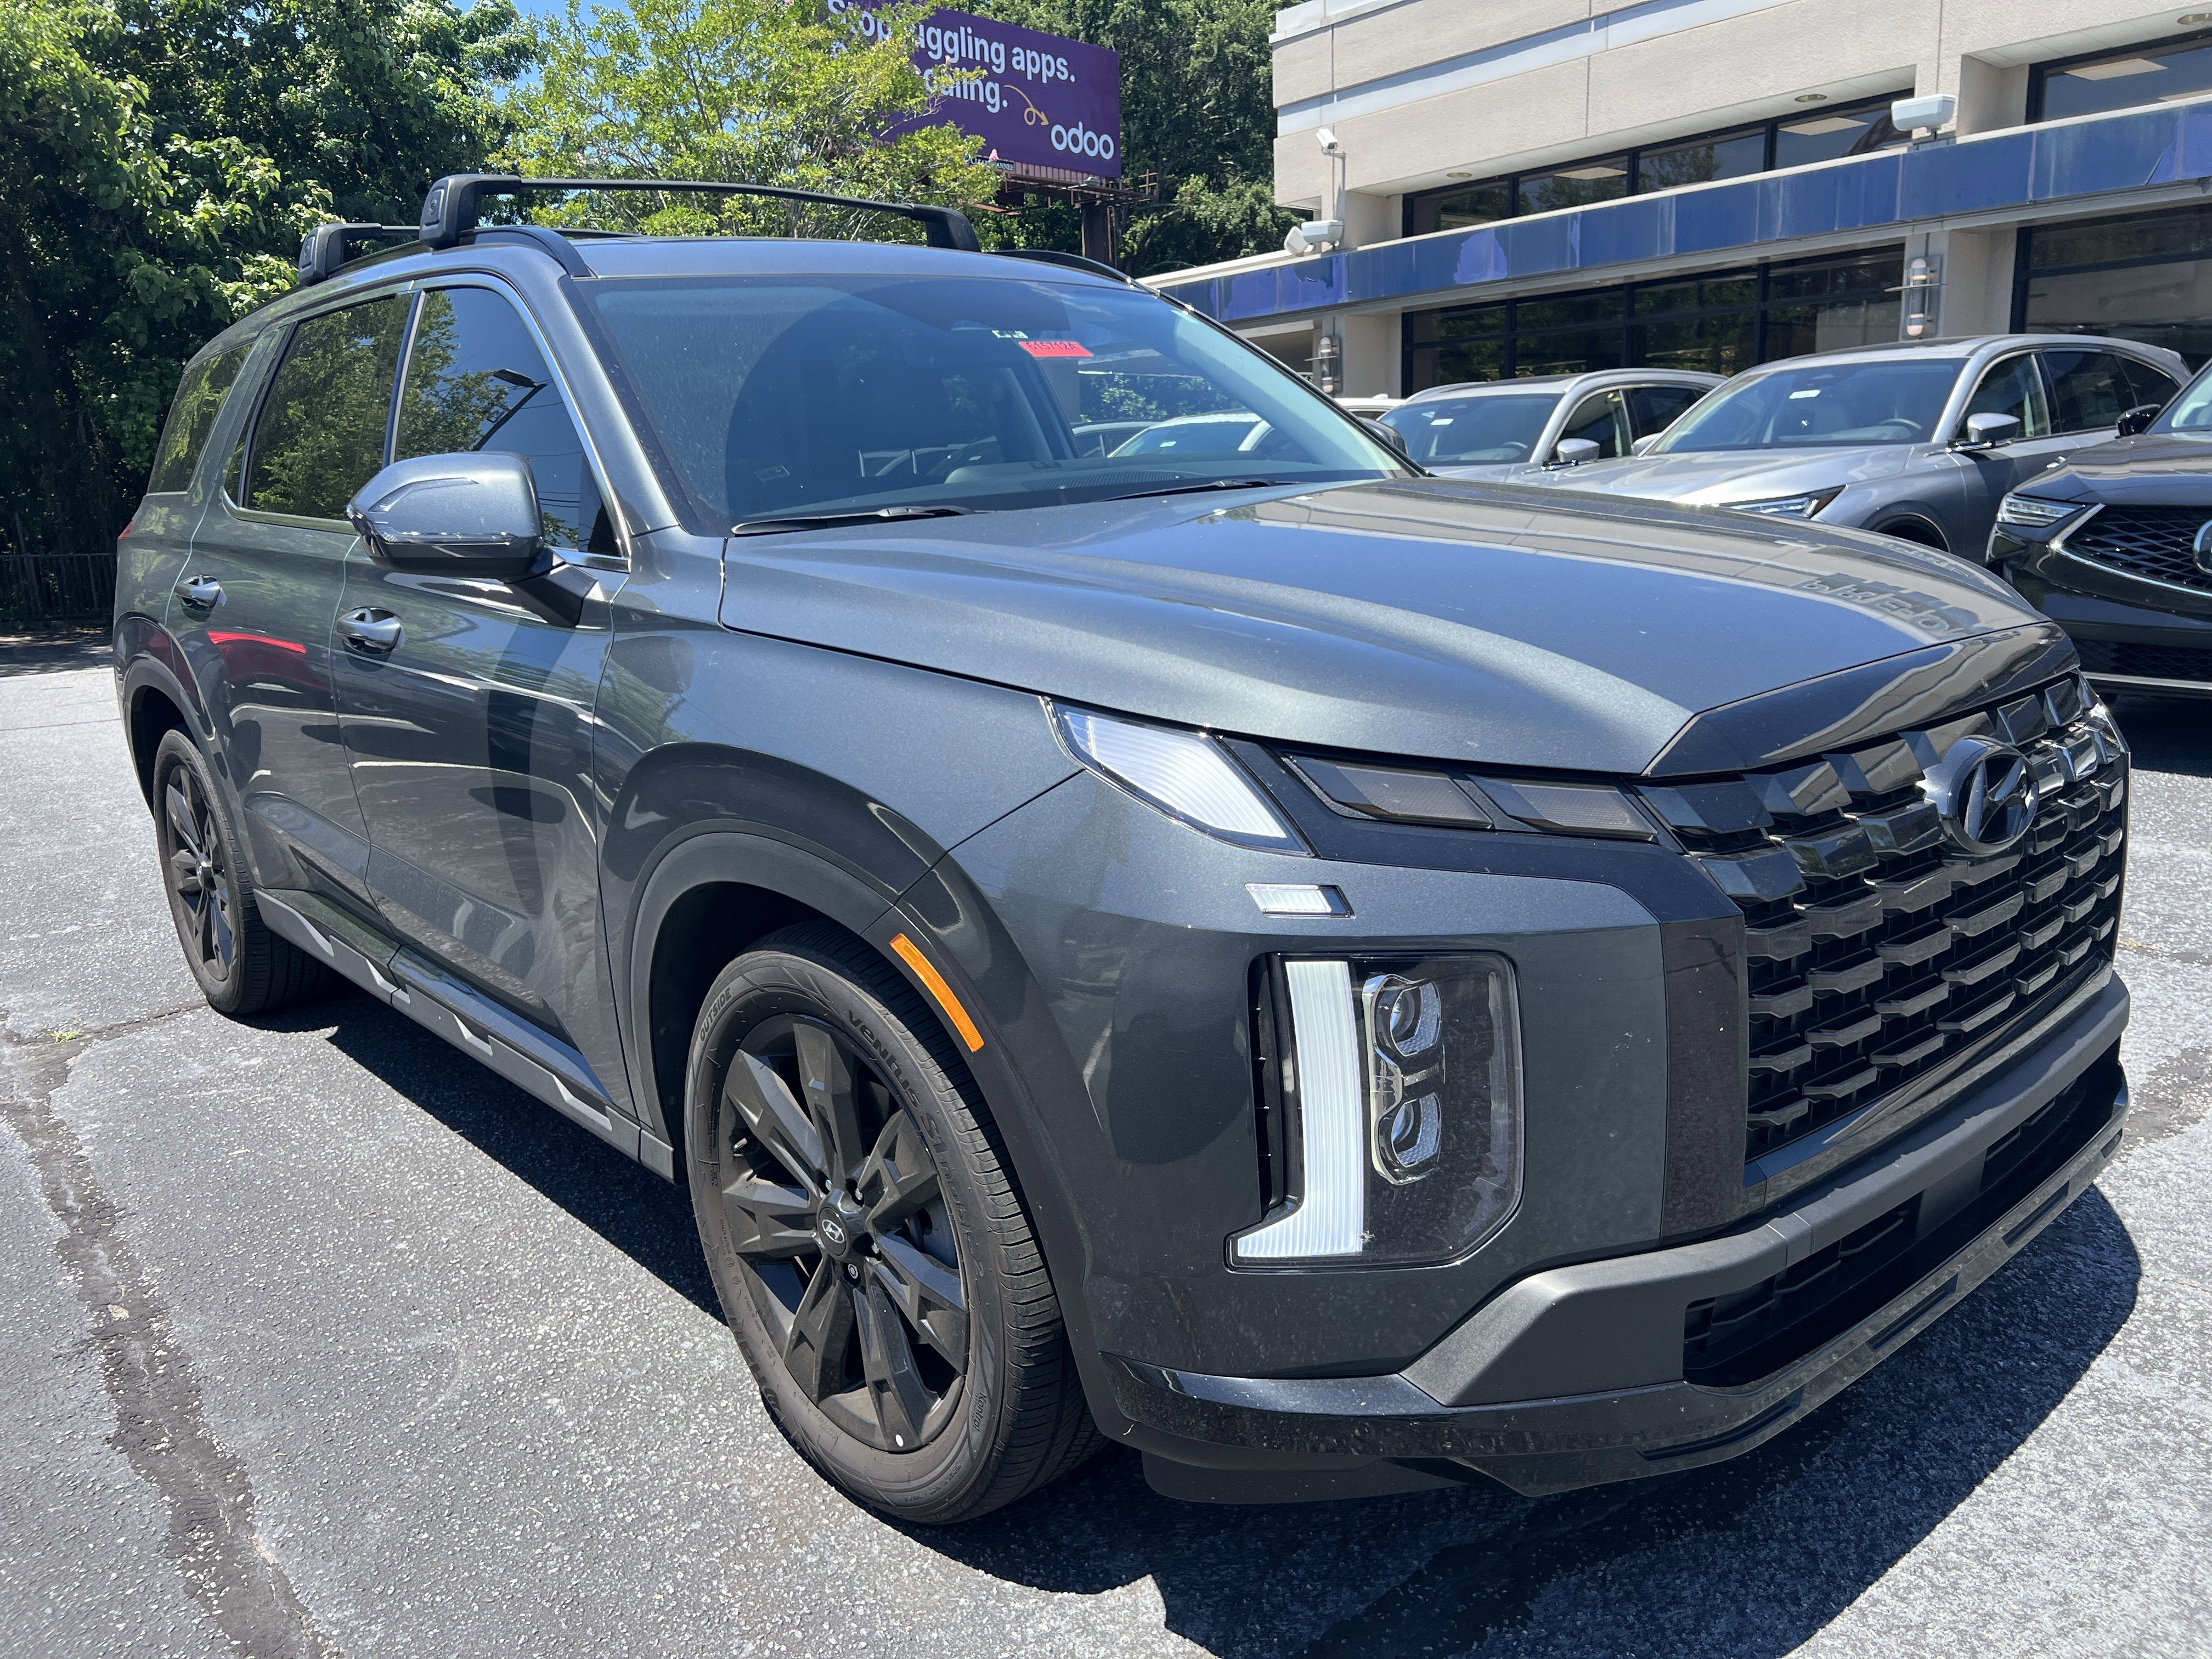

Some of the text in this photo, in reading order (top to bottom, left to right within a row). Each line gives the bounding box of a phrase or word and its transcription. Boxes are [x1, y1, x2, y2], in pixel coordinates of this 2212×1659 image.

[1012, 47, 1076, 83] apps.
[1051, 122, 1115, 160] odoo
[700, 987, 731, 1042] OUTSIDE
[920, 1111, 949, 1154] S1
[972, 1391, 988, 1432] Kontrol
